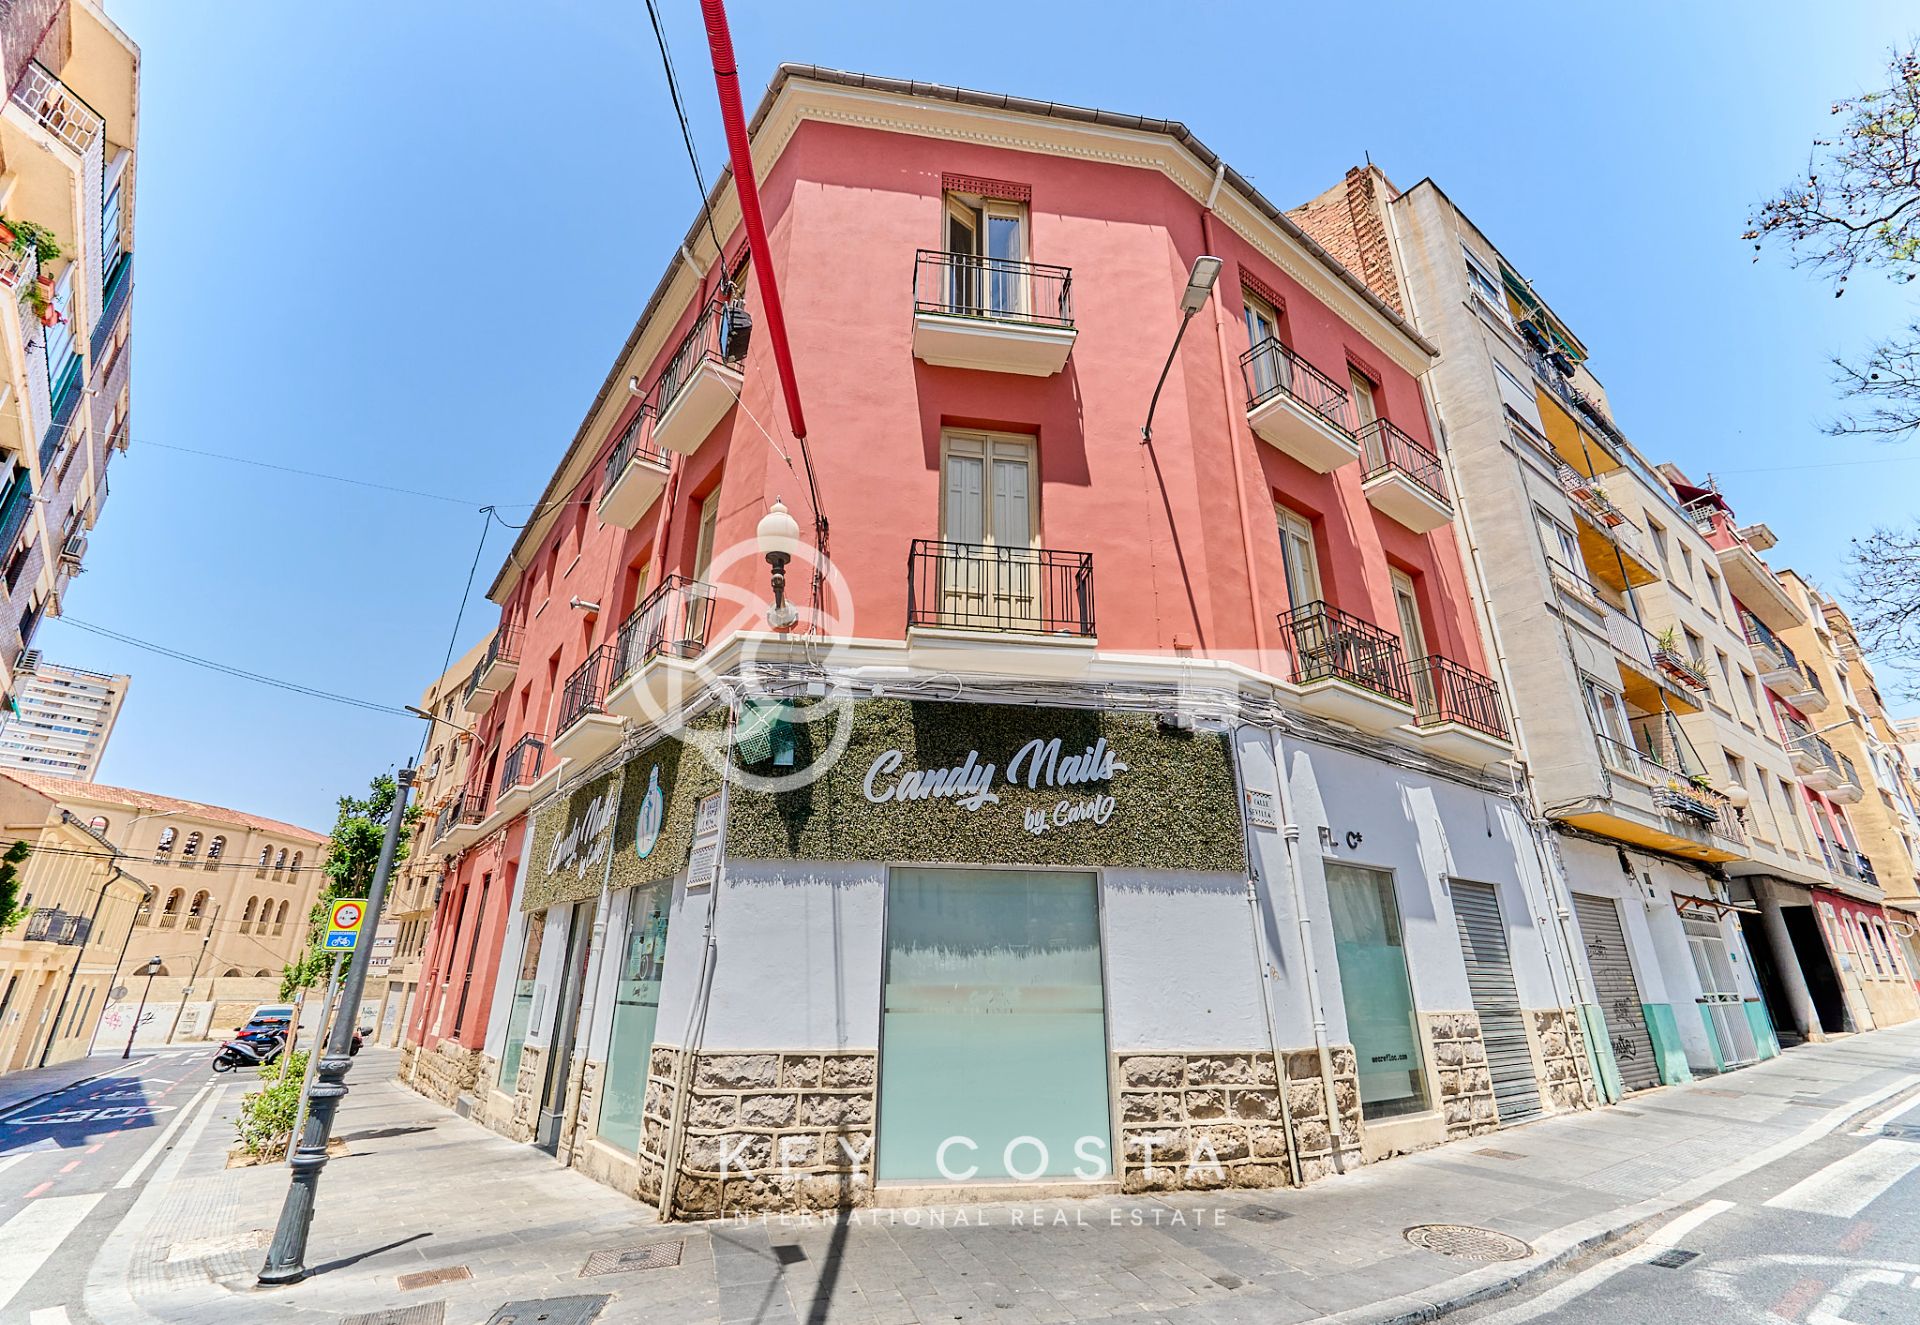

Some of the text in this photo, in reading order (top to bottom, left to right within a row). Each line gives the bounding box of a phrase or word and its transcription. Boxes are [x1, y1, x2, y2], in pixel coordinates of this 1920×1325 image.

[863, 737, 1128, 811] Candy Nails
[1024, 807, 1050, 835] by
[1249, 808, 1271, 818] SEVILLA
